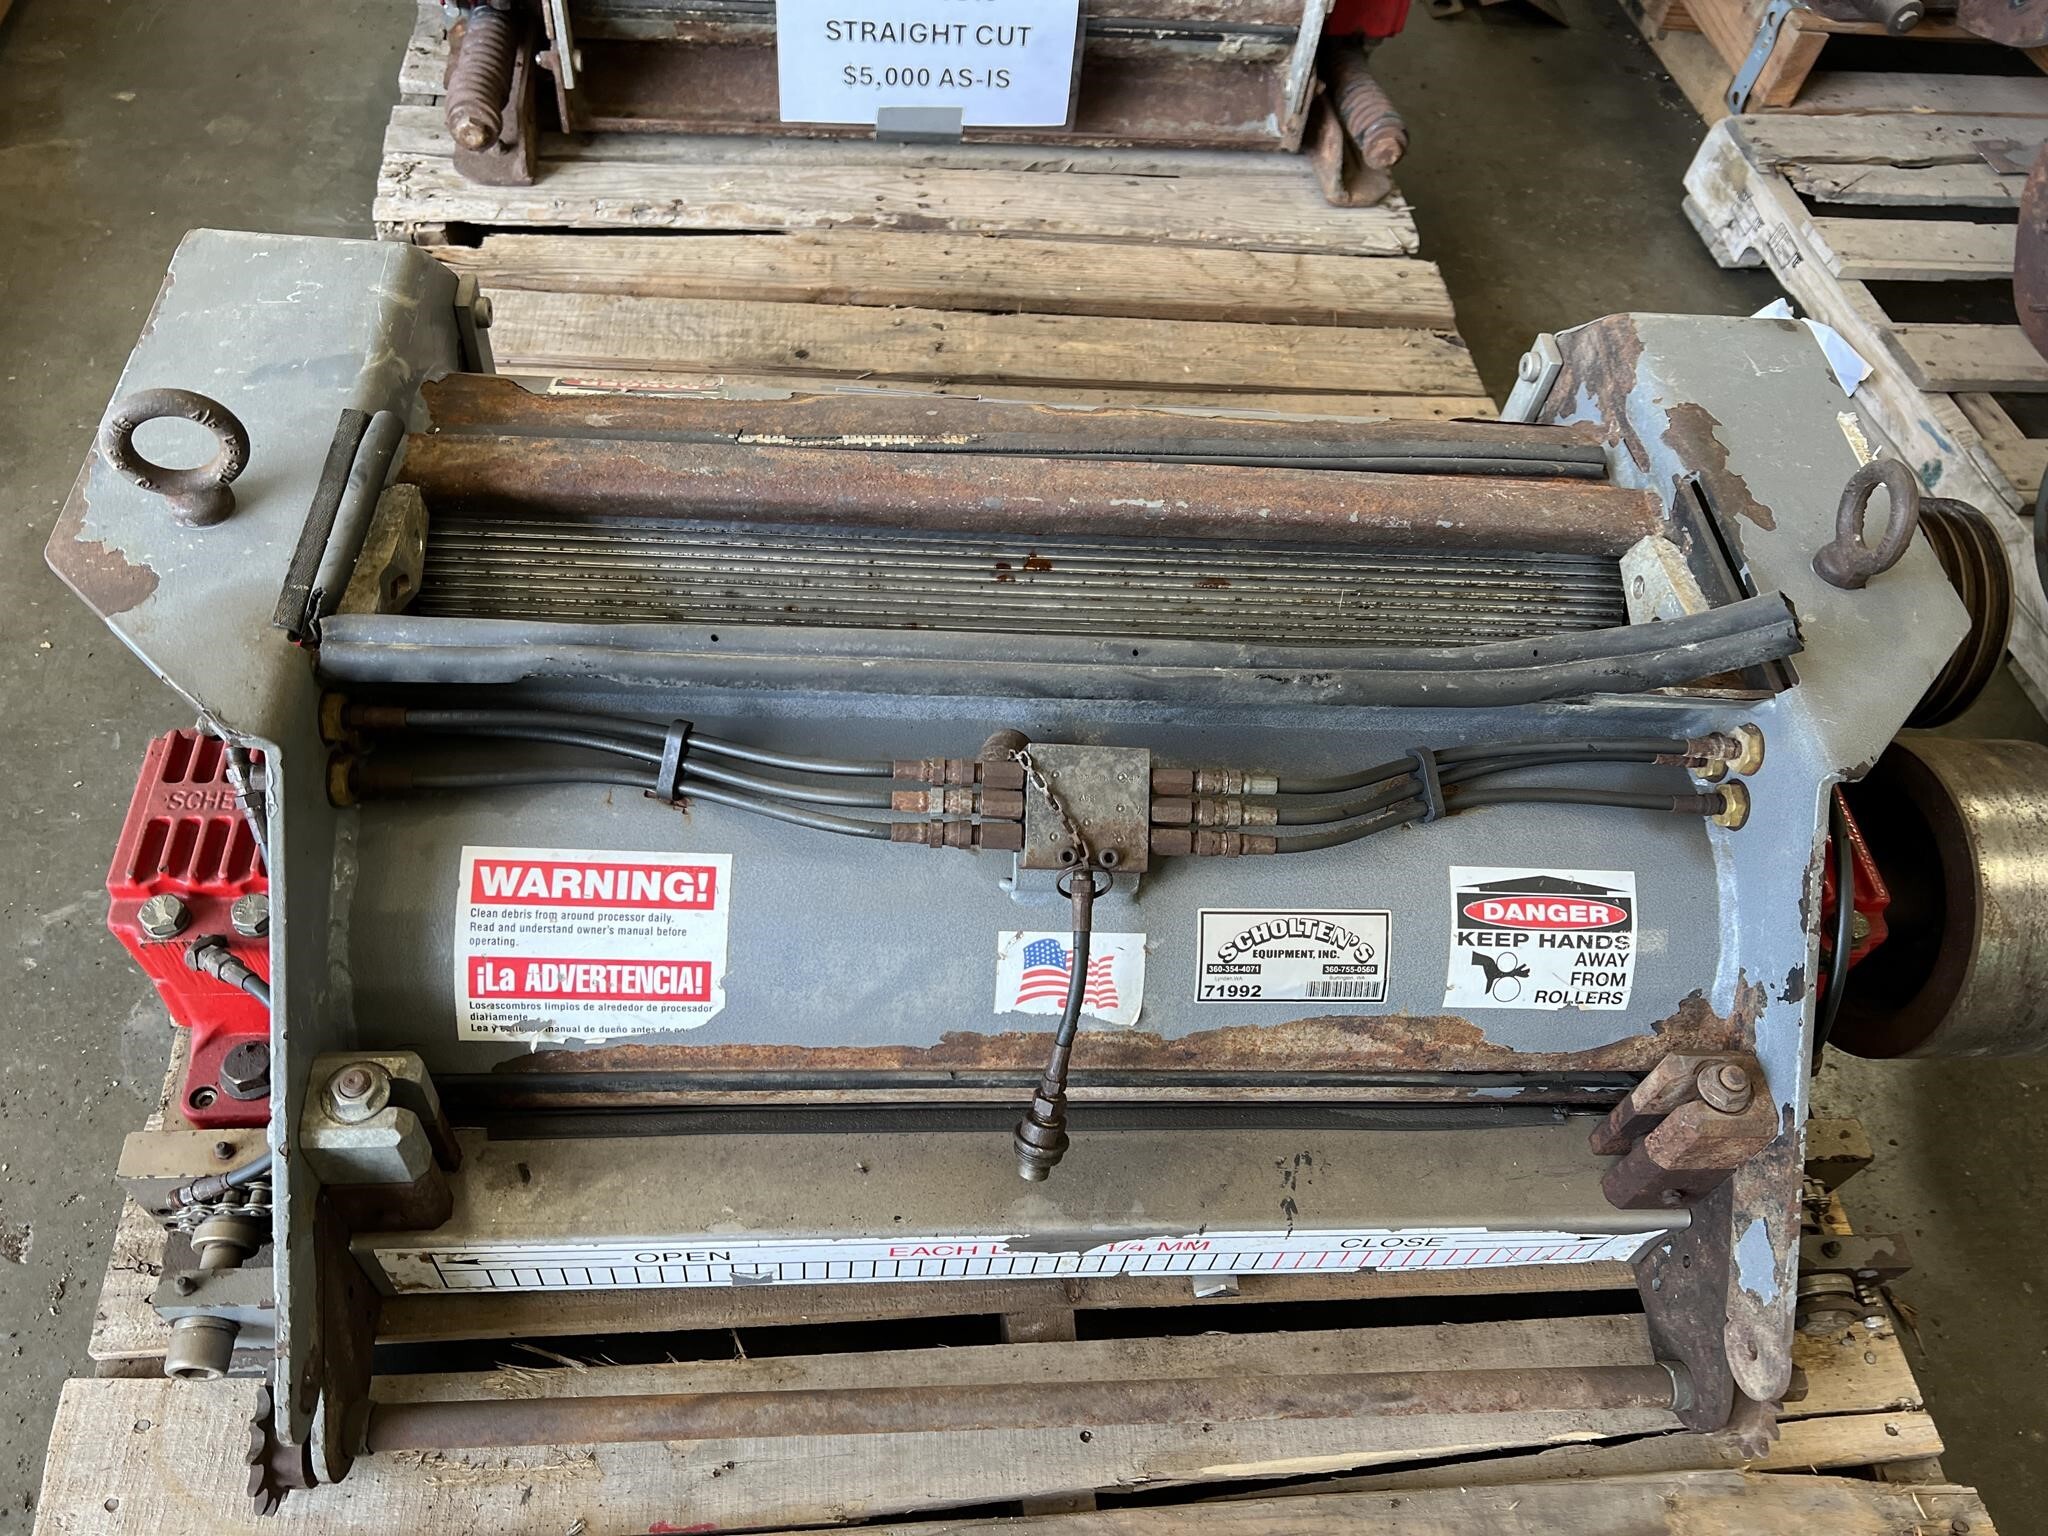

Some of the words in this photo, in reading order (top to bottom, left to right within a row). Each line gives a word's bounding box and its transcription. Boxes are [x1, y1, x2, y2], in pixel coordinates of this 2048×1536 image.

[825, 20, 967, 46] STRAIGHT
[975, 24, 1032, 47] CUT
[842, 65, 930, 90] $5,000
[938, 68, 1011, 88] AS-IS
[479, 866, 709, 903] WARNING!
[470, 908, 498, 918] Clean
[501, 909, 532, 919] debris
[535, 910, 558, 920] from
[561, 911, 594, 921] around
[598, 912, 645, 922] processor
[648, 912, 674, 924] daily.
[1483, 902, 1610, 923] DANGER
[470, 922, 495, 932] Read
[498, 923, 516, 933] and
[520, 923, 573, 934] understand
[577, 924, 614, 935] owner's
[618, 926, 653, 936] manual
[657, 926, 687, 937] before
[469, 937, 519, 948] operating.
[1218, 918, 1375, 963] SCHOLTEN'S
[1457, 932, 1529, 947] KEEP
[1538, 933, 1631, 950] HANDS
[1252, 949, 1315, 959] EQUIPMENT,
[1318, 949, 1340, 959] INC.
[1574, 952, 1630, 967] AWAY
[1209, 965, 1259, 973] 360-354-4071
[477, 962, 515, 995] ¡La
[525, 963, 703, 995] ADVERTENCIA!
[1570, 972, 1626, 986] FROM
[1204, 985, 1262, 997] 71992
[1534, 990, 1624, 1005] ROLLERS
[469, 1001, 486, 1010] Los
[490, 1002, 542, 1010] ascombros
[545, 1002, 580, 1011] limpios
[583, 1003, 595, 1011] de
[598, 1003, 643, 1012] alrededor
[646, 1004, 658, 1012] de
[661, 1004, 713, 1013] procesador
[471, 1023, 488, 1032] Lea
[584, 1025, 595, 1033] de
[1107, 1242, 1145, 1252] 1/4
[1157, 1241, 1210, 1251] MM
[1340, 1237, 1448, 1249] CLOSE
[635, 1251, 731, 1263] OPEN
[889, 1245, 978, 1257] EACH
